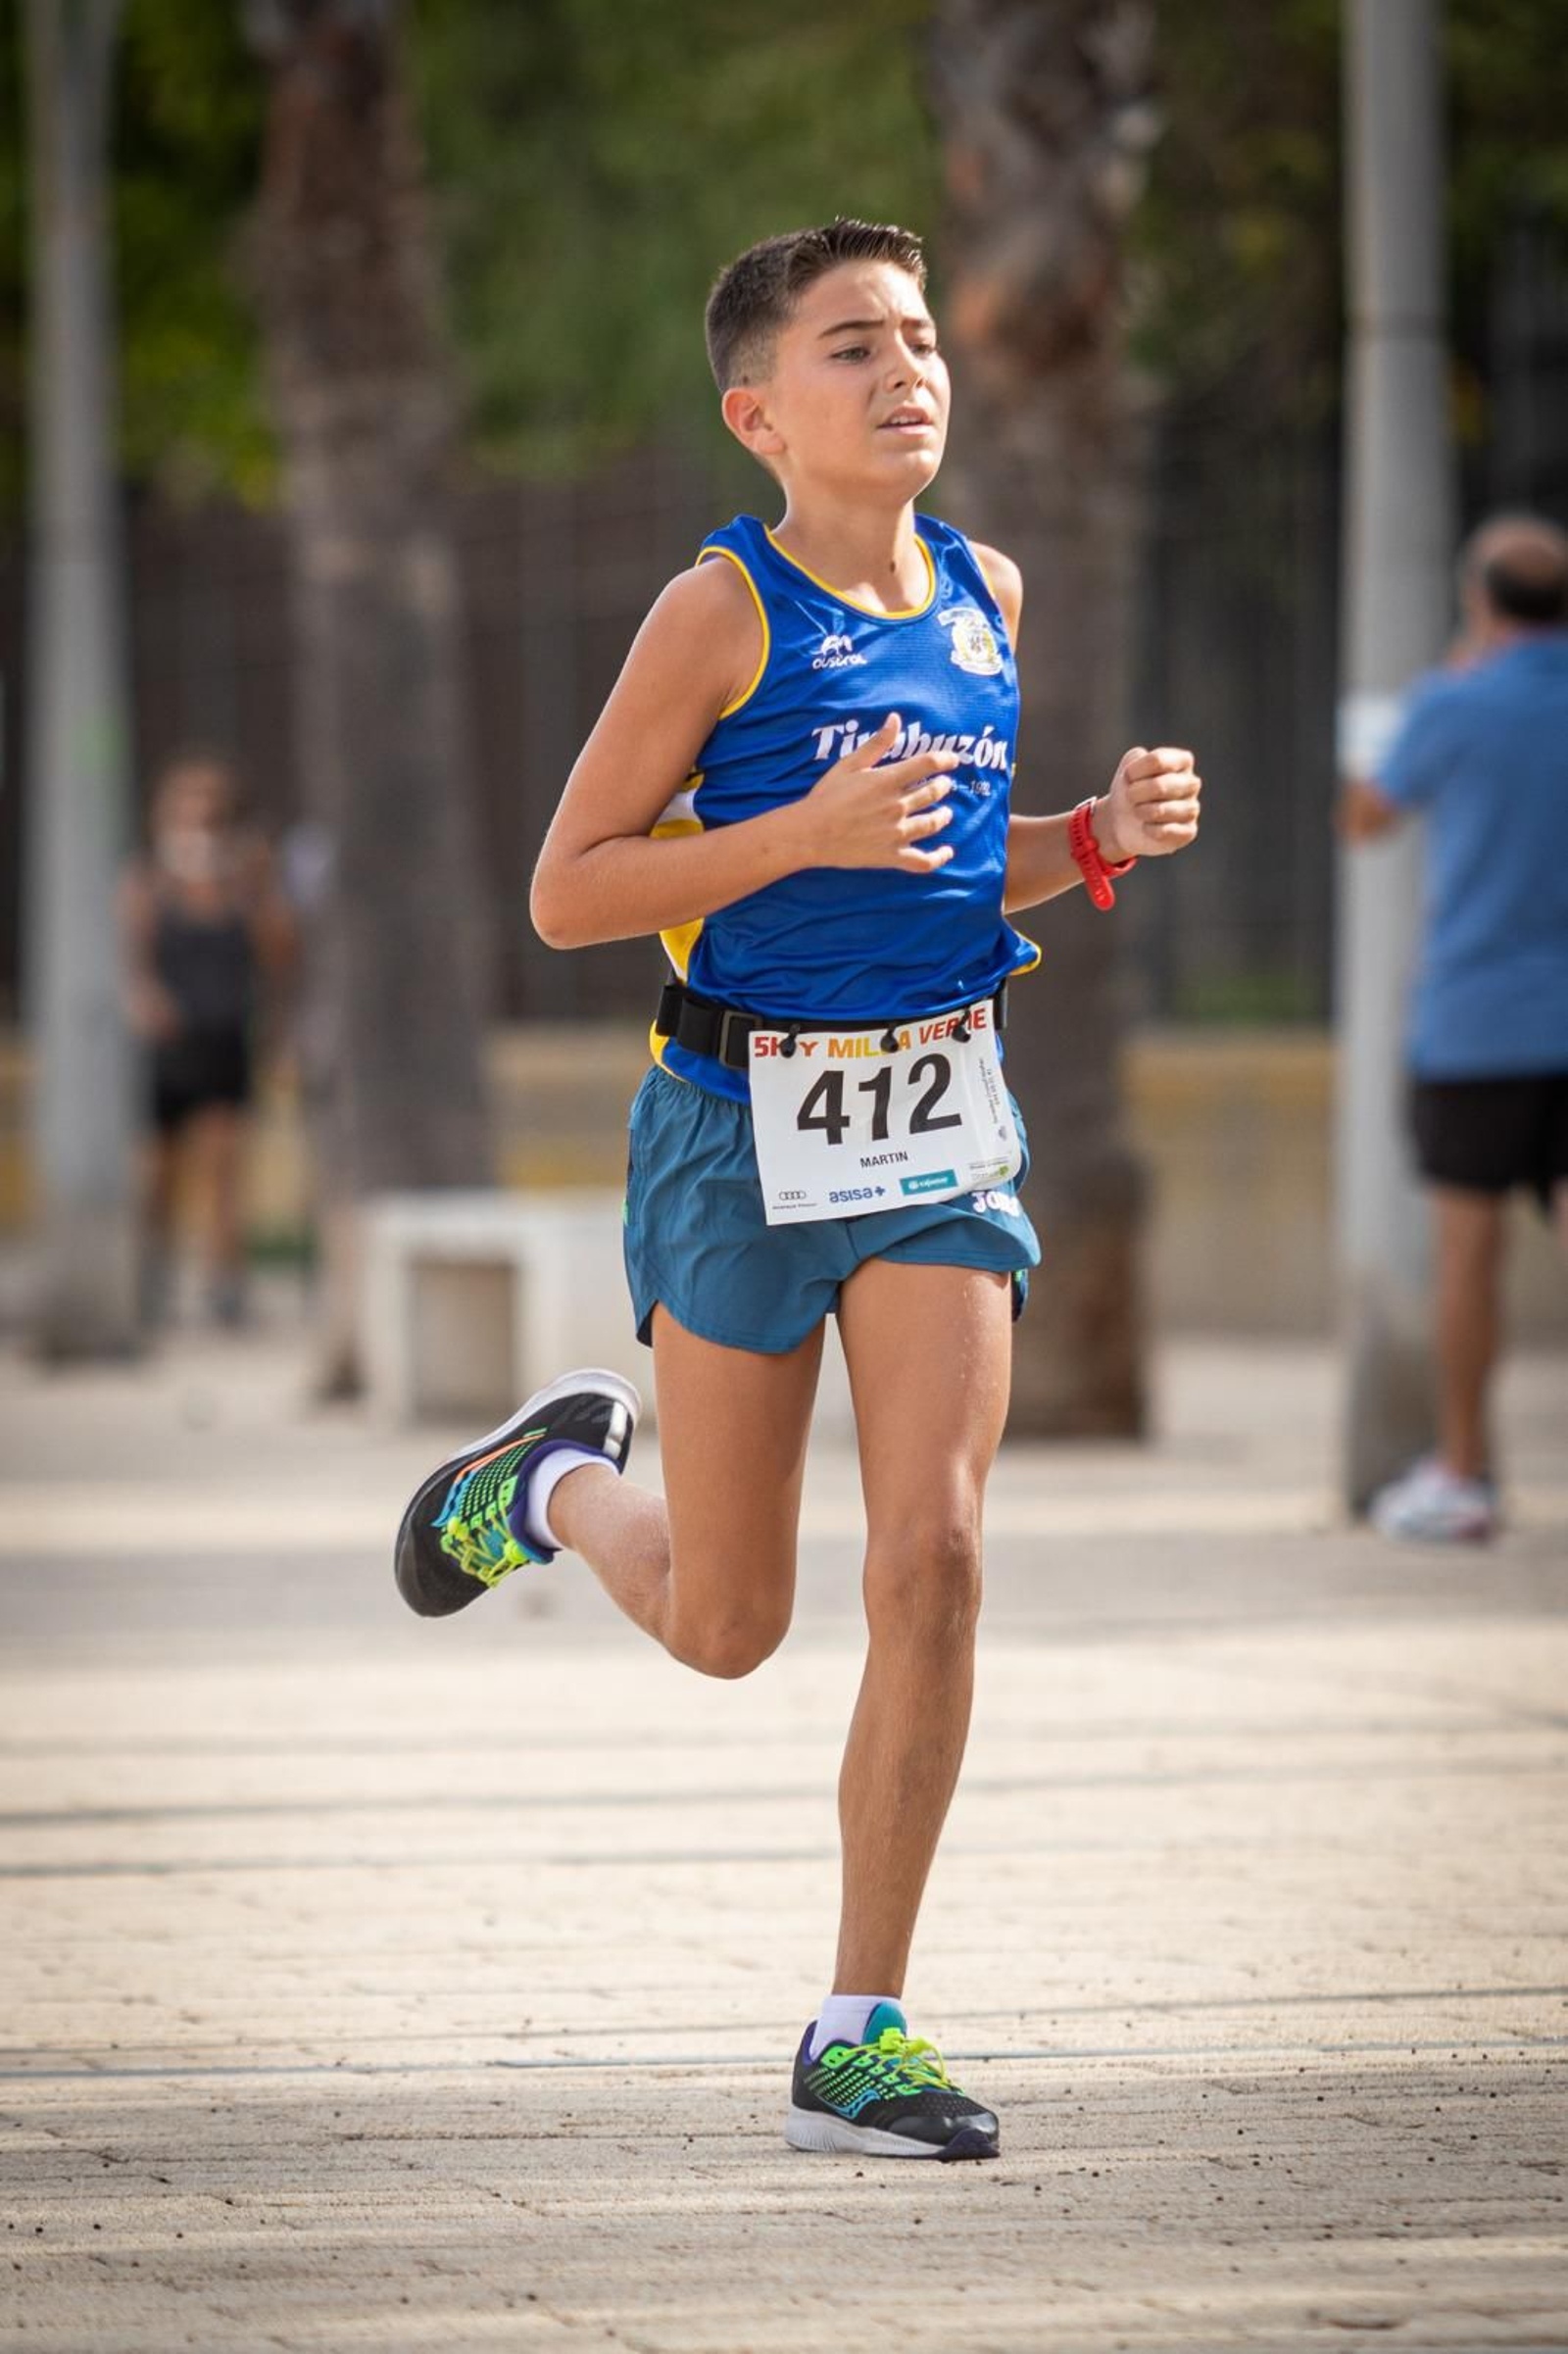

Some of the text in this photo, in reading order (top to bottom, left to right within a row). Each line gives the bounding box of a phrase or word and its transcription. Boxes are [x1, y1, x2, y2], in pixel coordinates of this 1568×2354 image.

[799, 1041, 819, 1057] Y
[827, 1029, 911, 1058] MILA
[797, 1053, 962, 1146] 412
[859, 1152, 908, 1168] MARTIN
[828, 1188, 873, 1203] asisa
